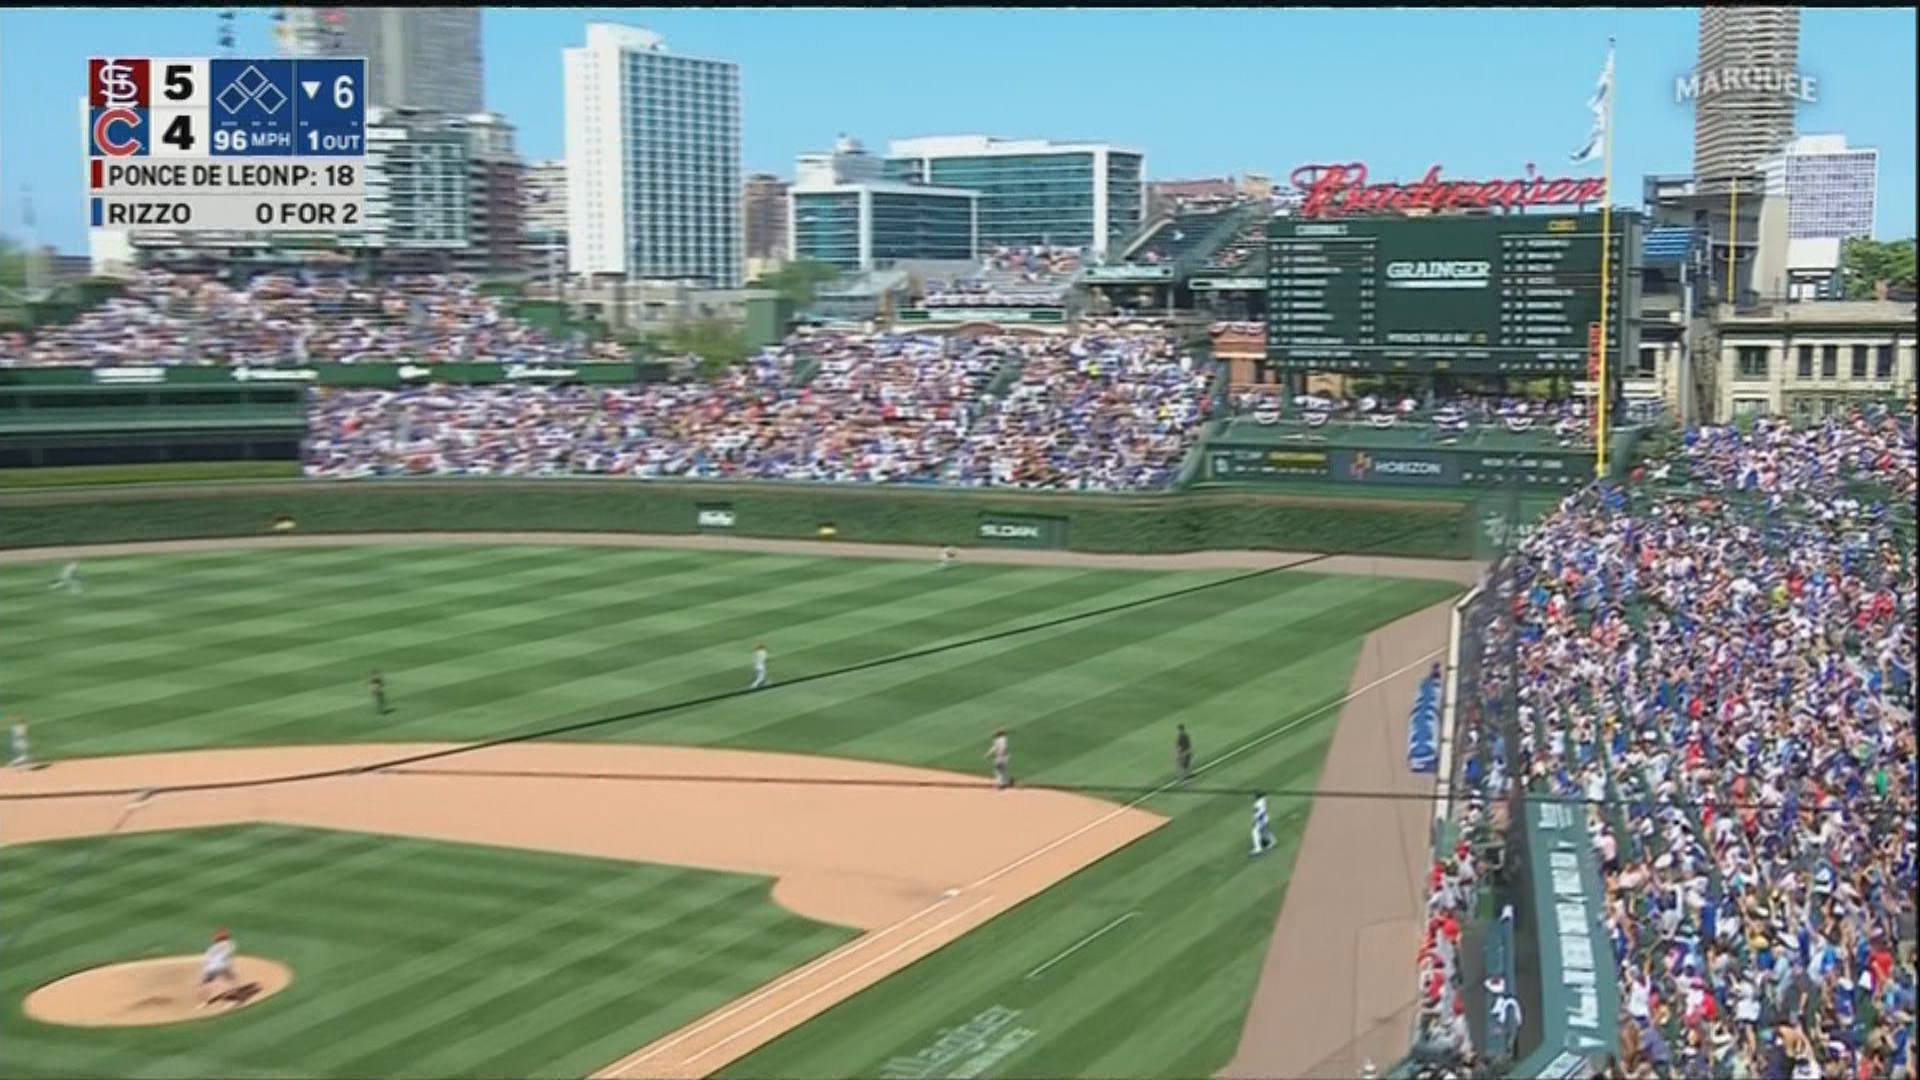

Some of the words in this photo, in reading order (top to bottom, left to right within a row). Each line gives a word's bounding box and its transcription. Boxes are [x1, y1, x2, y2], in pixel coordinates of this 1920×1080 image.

[1291, 163, 1607, 217] Budweiser
[1386, 261, 1492, 279] GRAINGER
[1375, 460, 1442, 475] HORIZON
